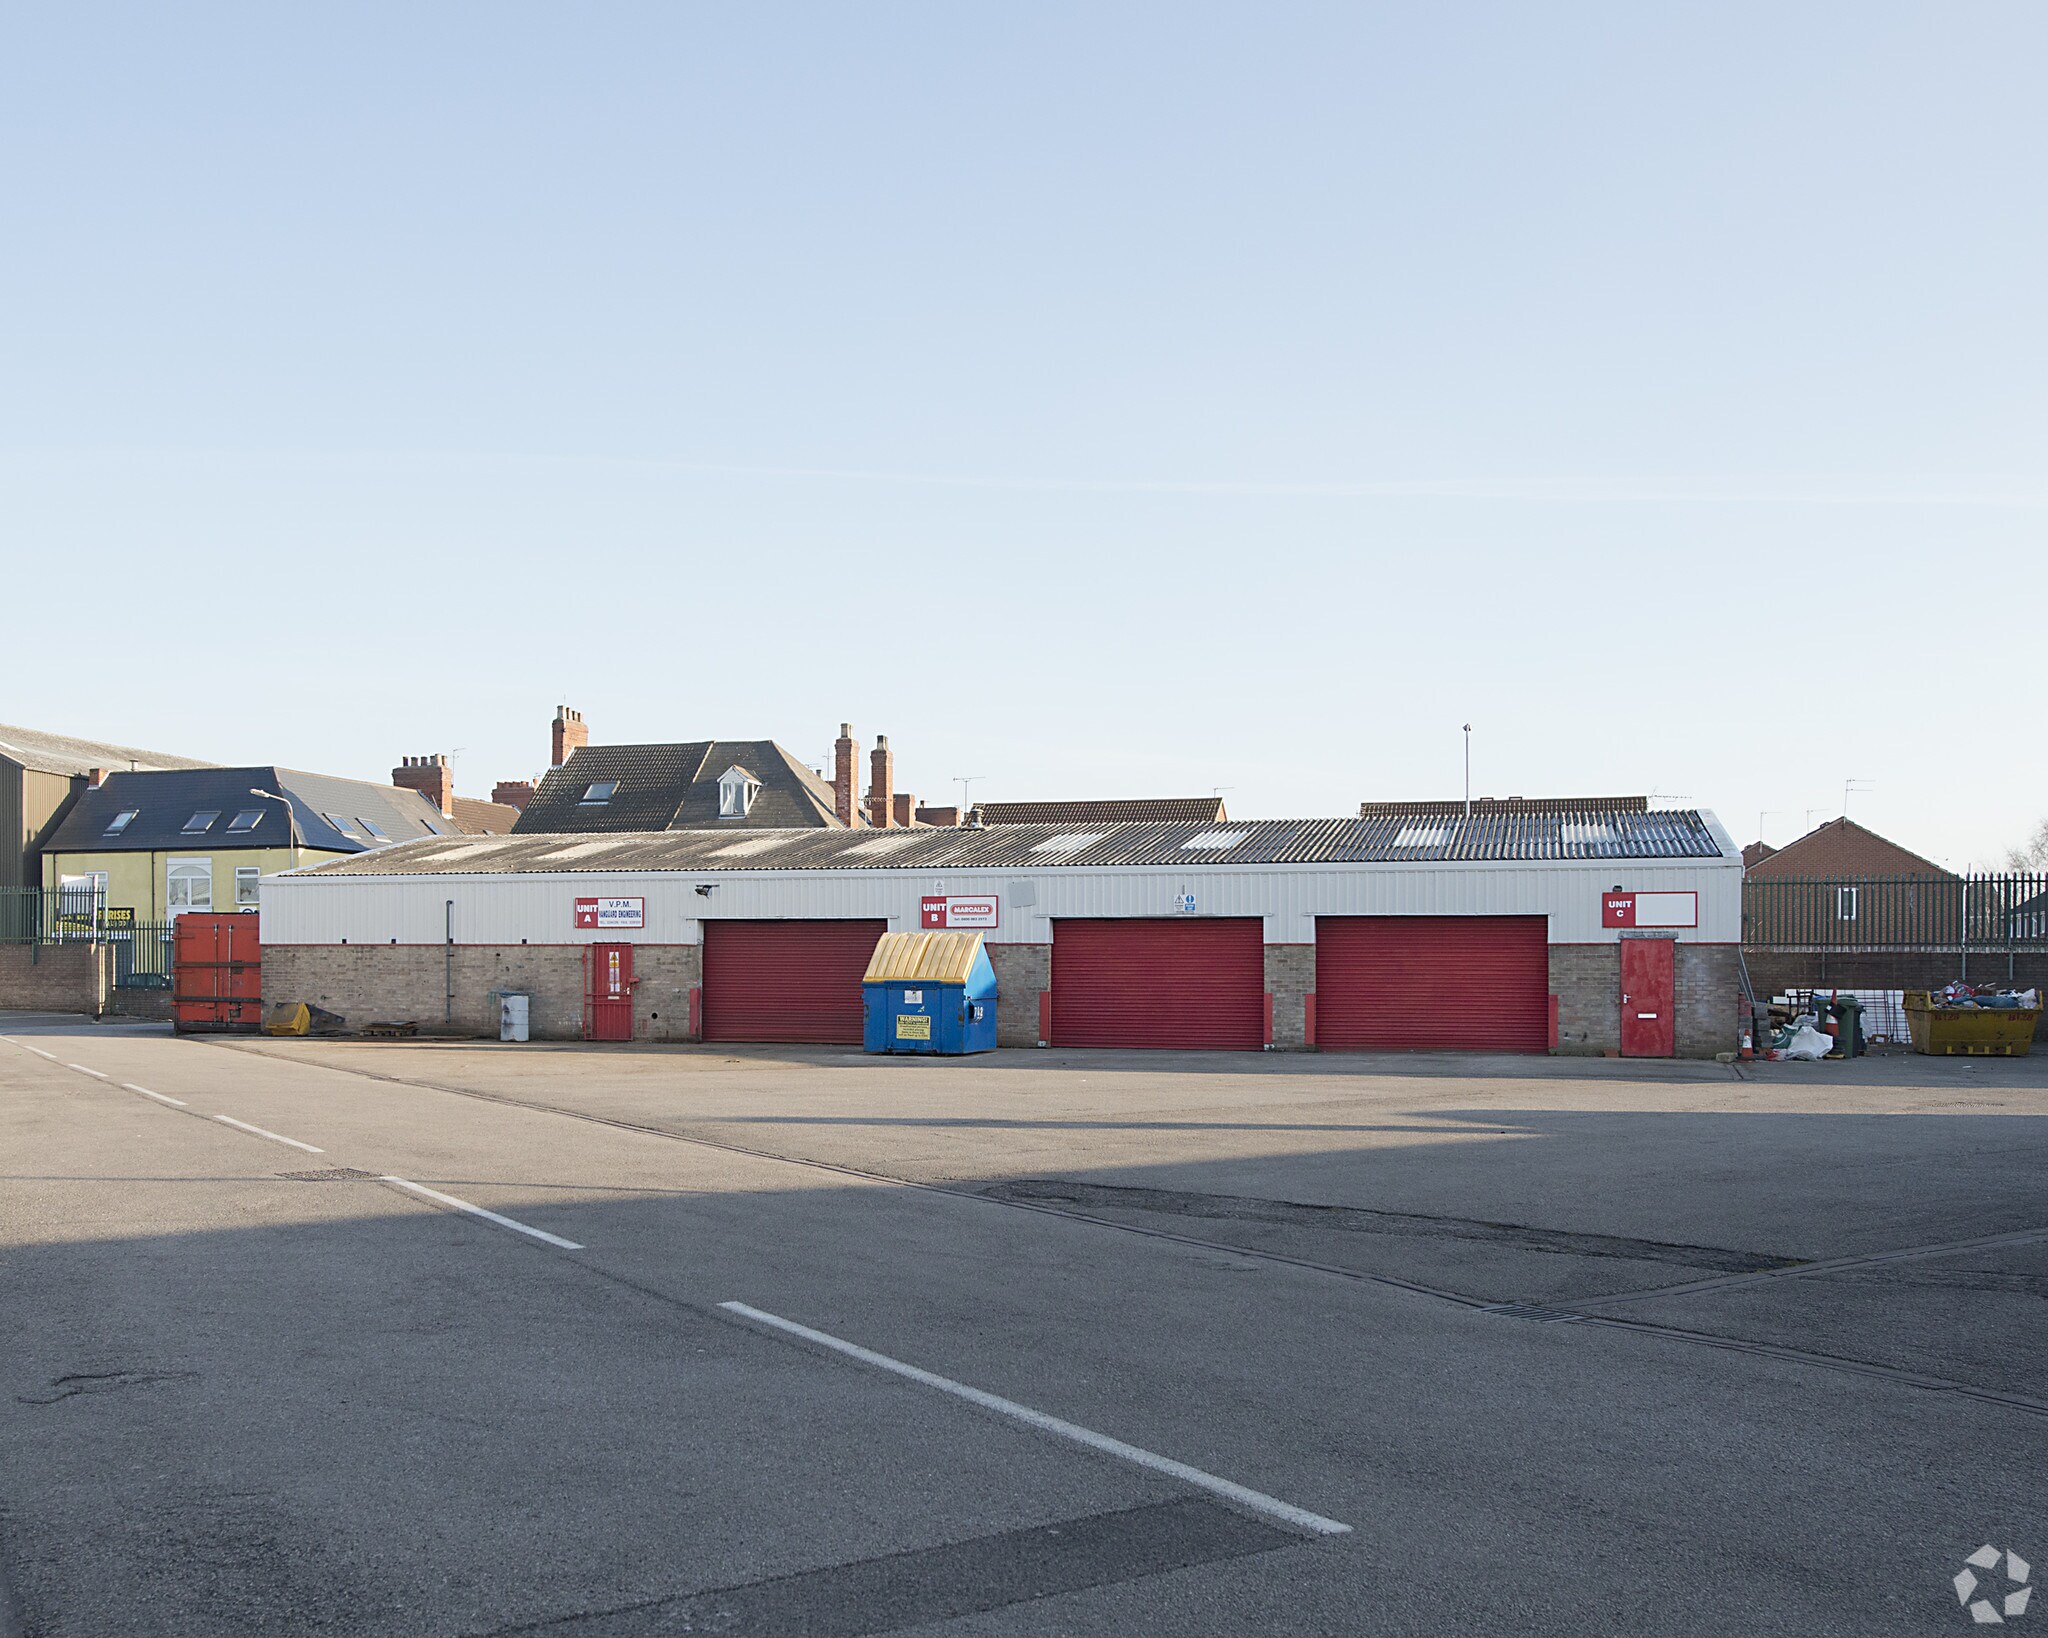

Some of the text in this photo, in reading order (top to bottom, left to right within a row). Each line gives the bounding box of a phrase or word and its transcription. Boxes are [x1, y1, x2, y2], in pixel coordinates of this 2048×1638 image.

[577, 904, 598, 913] UNIT
[608, 900, 632, 908] V.P.M.
[922, 903, 946, 912] UNIT
[1608, 900, 1632, 908] UNIT
[583, 914, 592, 923] A
[930, 913, 939, 922] B
